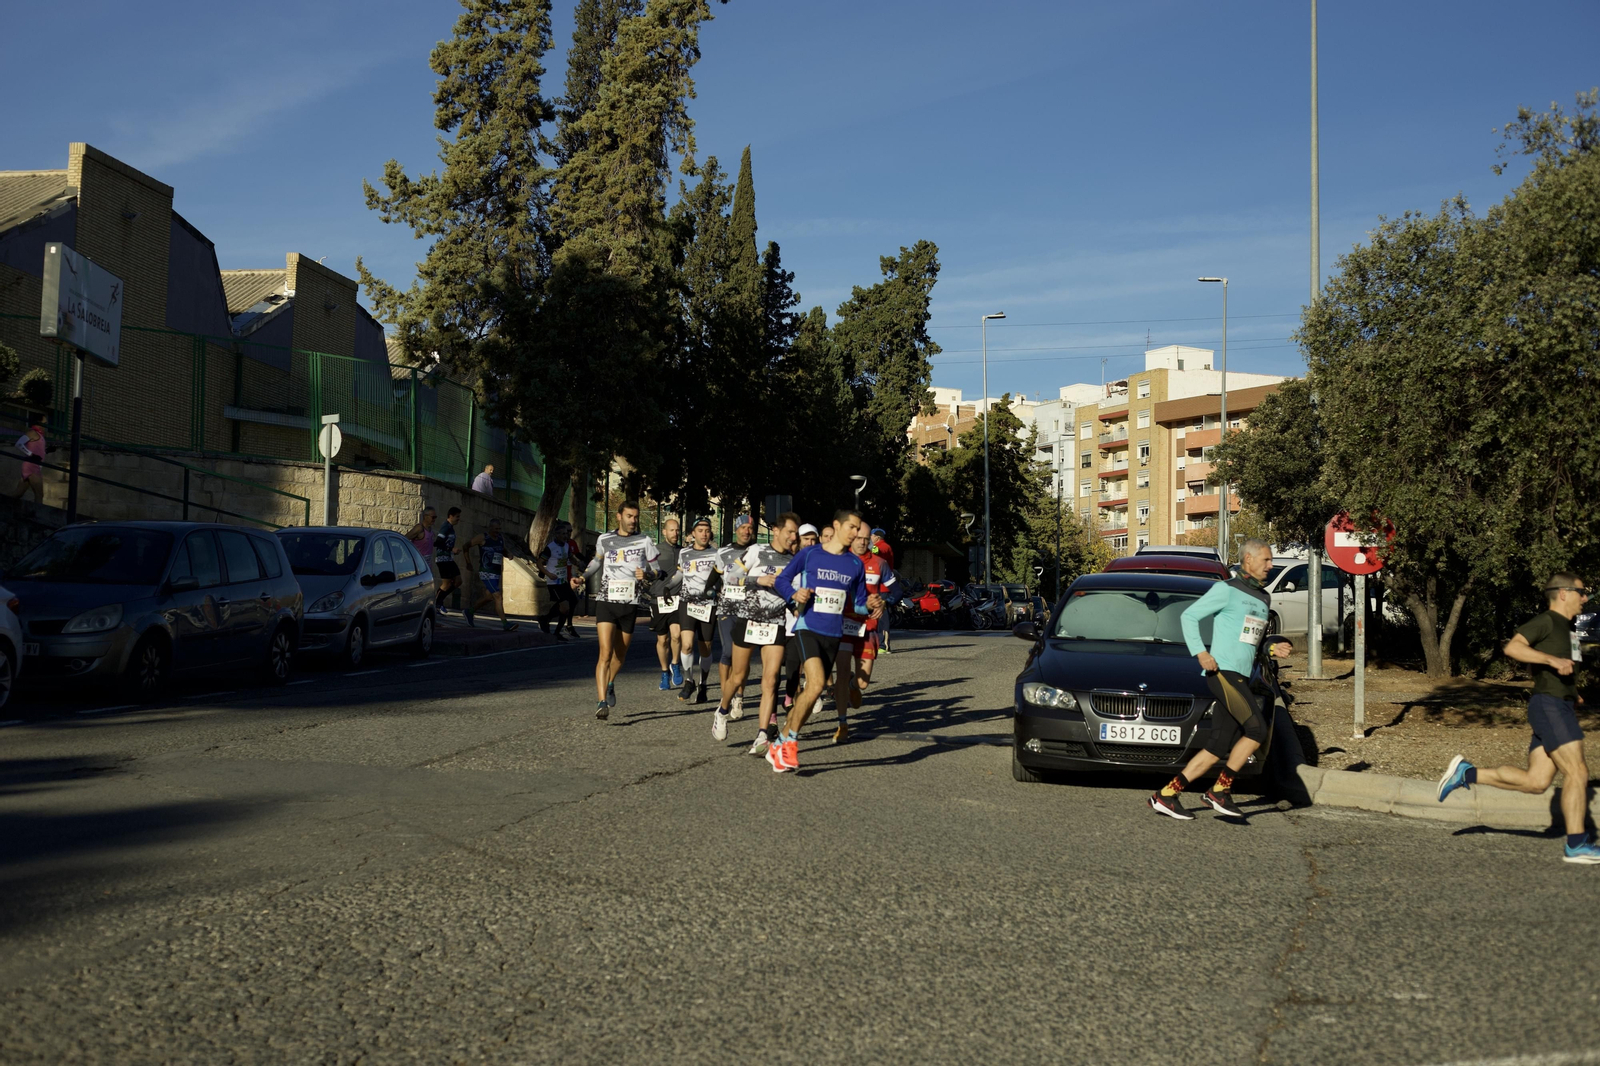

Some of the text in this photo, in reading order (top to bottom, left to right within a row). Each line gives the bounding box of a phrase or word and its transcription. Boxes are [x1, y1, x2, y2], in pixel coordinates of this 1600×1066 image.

[67, 296, 75, 316] LA
[77, 302, 111, 335] SALOBREJA
[824, 596, 839, 605] 184
[692, 607, 705, 615] 200
[844, 623, 859, 631] 206
[758, 629, 769, 637] 53
[1110, 725, 1177, 742] 5812 GCG
